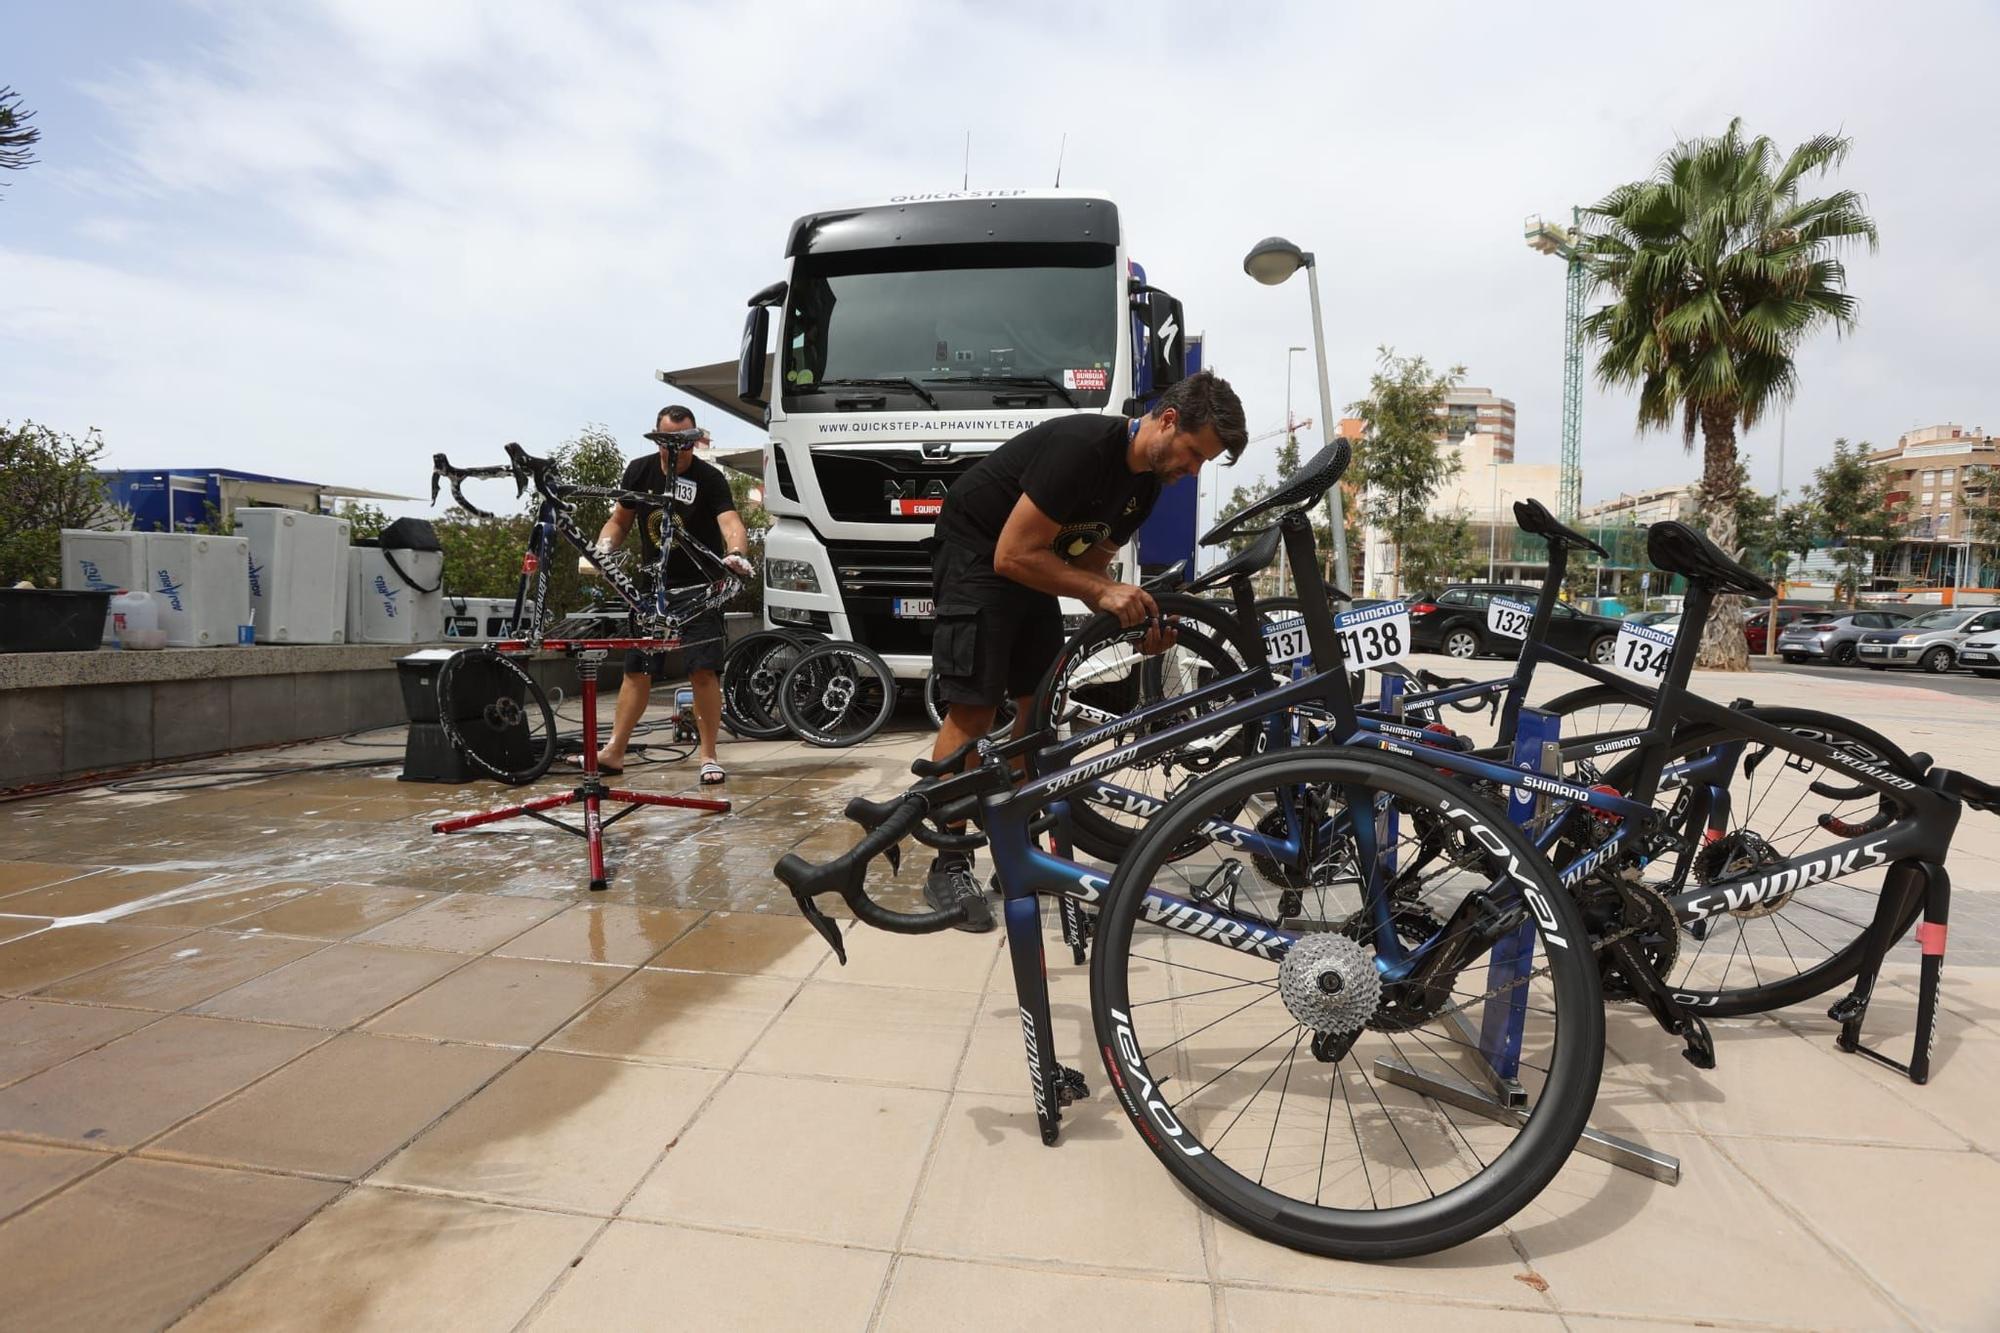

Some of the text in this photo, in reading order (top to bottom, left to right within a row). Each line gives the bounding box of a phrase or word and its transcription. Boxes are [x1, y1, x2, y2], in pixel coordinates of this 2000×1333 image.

[677, 485, 693, 500] 133
[884, 479, 949, 501] MA
[913, 505, 941, 514] EQUIPO
[1266, 617, 1305, 634] SHIMAN
[1341, 602, 1405, 626] SHIMANO
[1494, 608, 1525, 636] 132
[1271, 631, 1303, 659] 137
[1348, 622, 1402, 664] 138
[1622, 622, 1675, 645] SHIMANO
[1623, 640, 1668, 678] 134
[1080, 714, 1144, 748] SPECIALIZED
[1380, 723, 1422, 739] SHIMANO
[1594, 736, 1641, 754] SHIMANO
[1043, 746, 1139, 797] SPECIALIZED
[1828, 751, 1917, 790] SPECIALIZED
[1523, 776, 1589, 802] SHIMANO
[1446, 808, 1569, 949] roval
[1682, 839, 1890, 926] S-WORKS
[1019, 1005, 1049, 1120] SPECIALIZED
[1110, 1007, 1205, 1157] roval
